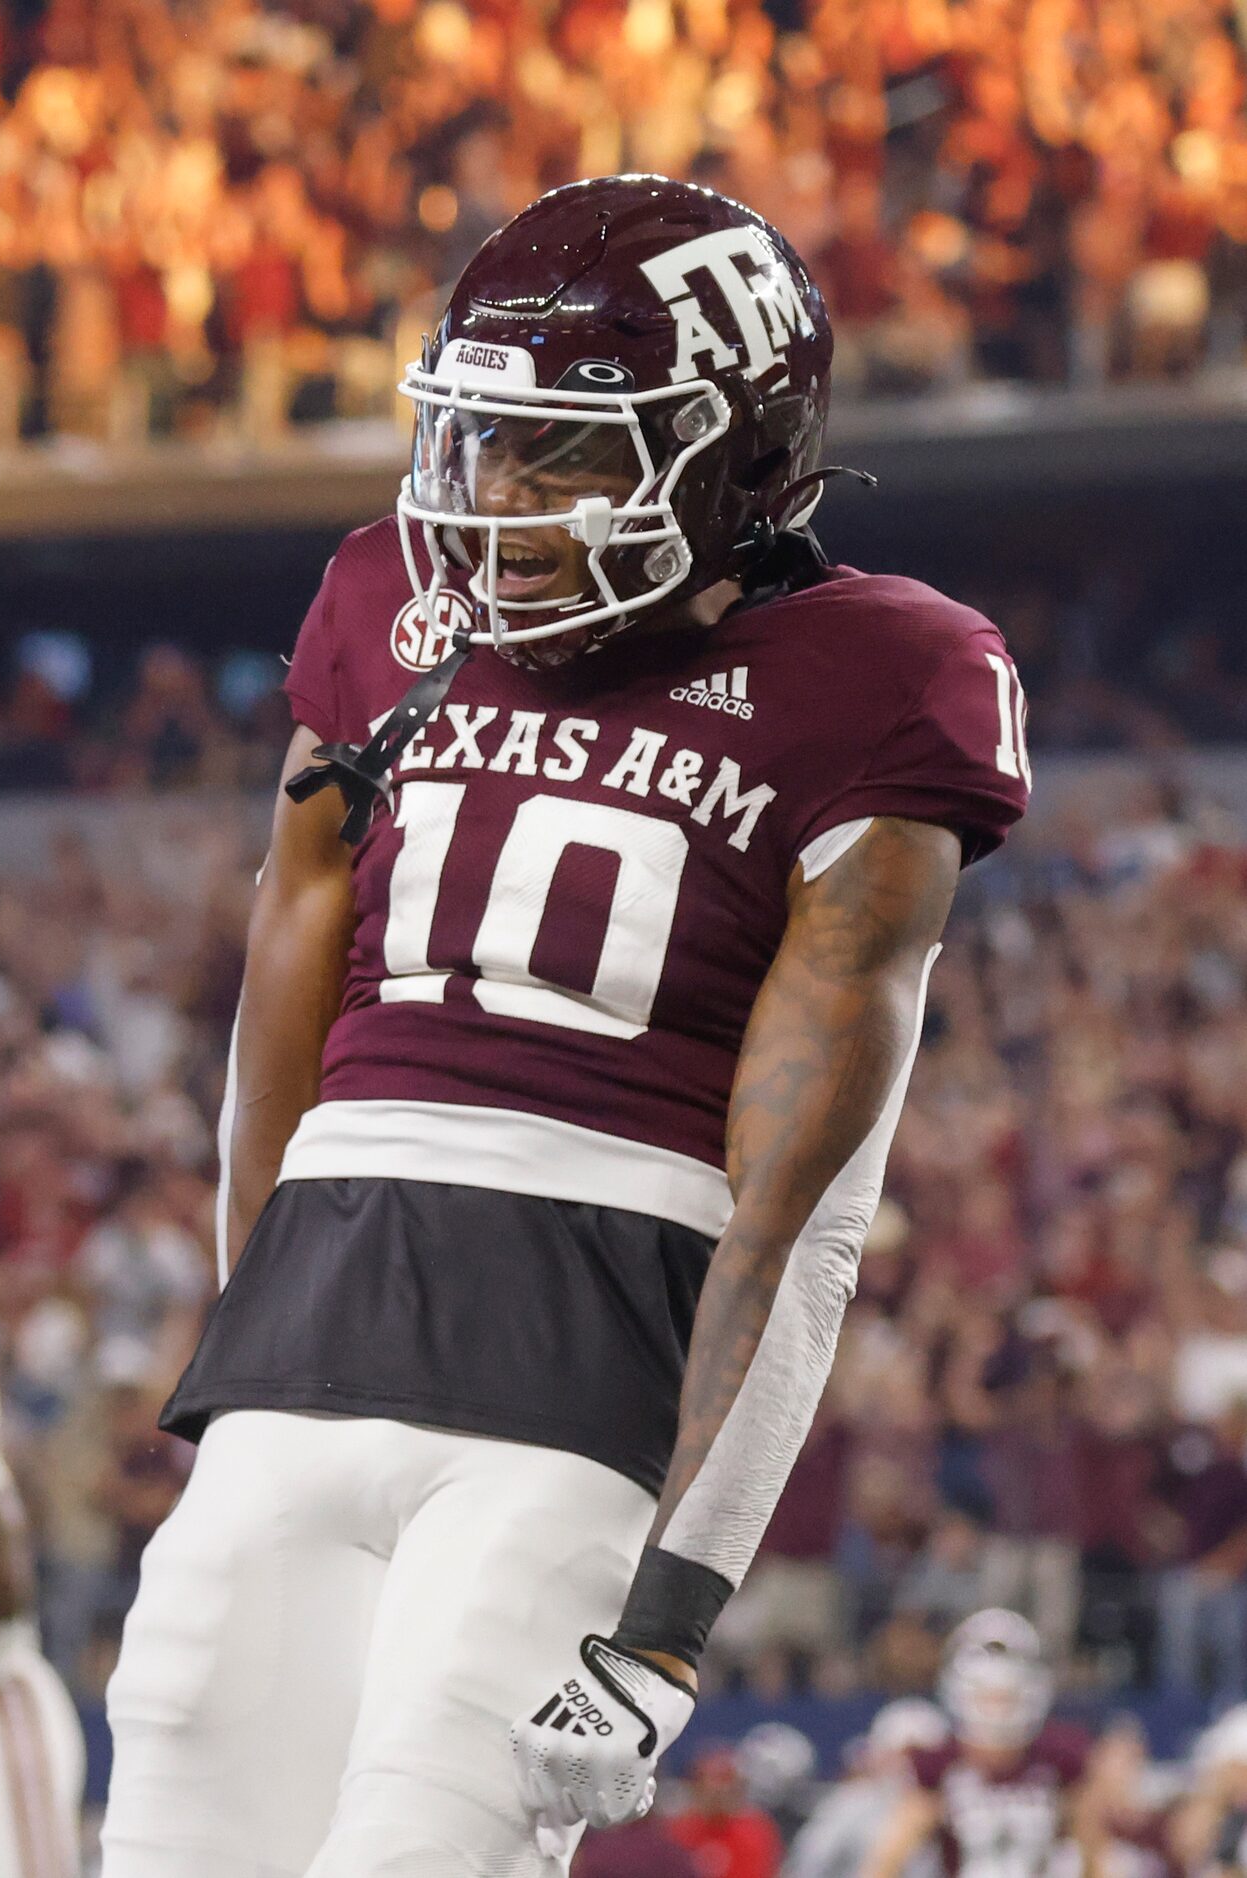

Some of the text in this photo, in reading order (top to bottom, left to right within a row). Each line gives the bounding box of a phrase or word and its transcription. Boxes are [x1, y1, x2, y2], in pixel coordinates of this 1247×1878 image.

[455, 344, 509, 371] AGGIES
[669, 687, 755, 720] adidas
[368, 702, 778, 852] EXAS A&M
[379, 780, 690, 1041] 10
